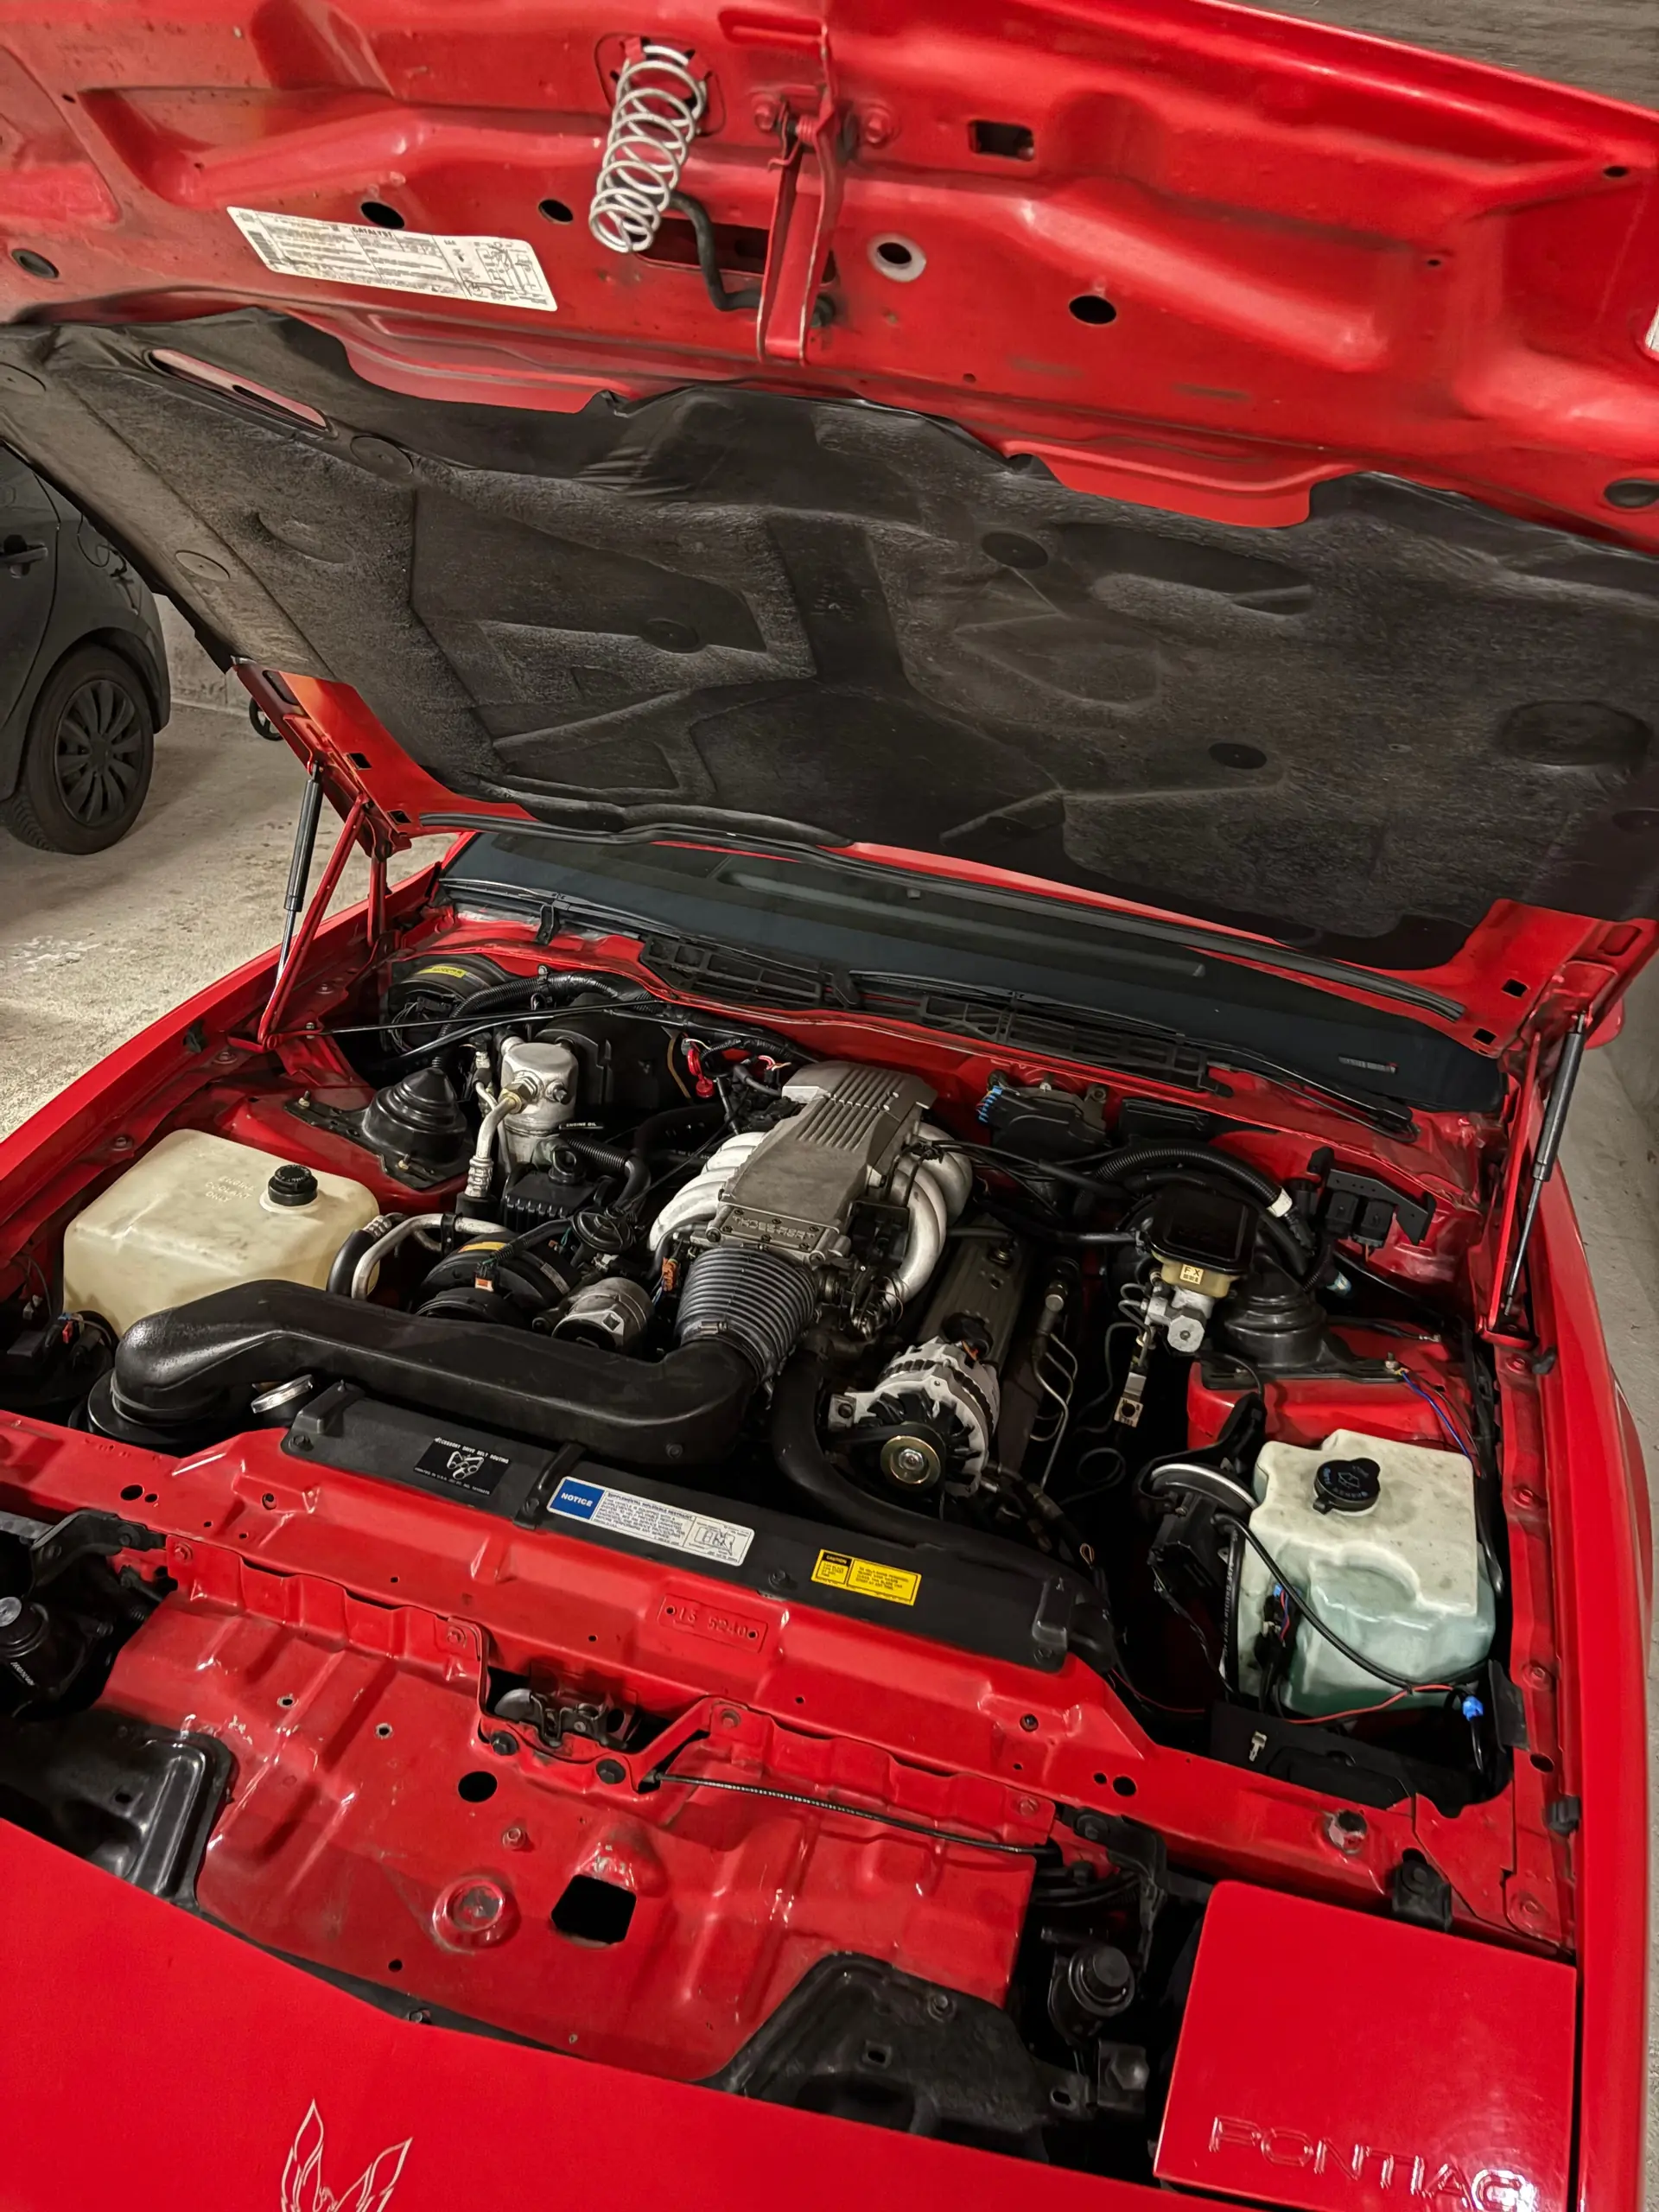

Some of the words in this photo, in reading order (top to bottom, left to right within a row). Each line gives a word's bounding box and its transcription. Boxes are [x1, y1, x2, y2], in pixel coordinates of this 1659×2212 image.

[350, 226, 393, 239] CATALYST
[205, 1181, 252, 1200] COOLANT
[219, 1176, 255, 1192] ENGINE
[206, 1191, 232, 1203] ONLY
[489, 1454, 509, 1464] ROUTING
[561, 1492, 594, 1507] NOTICE
[826, 1554, 847, 1564] CAUTION
[1209, 2116, 1535, 2212] PONTIAC
